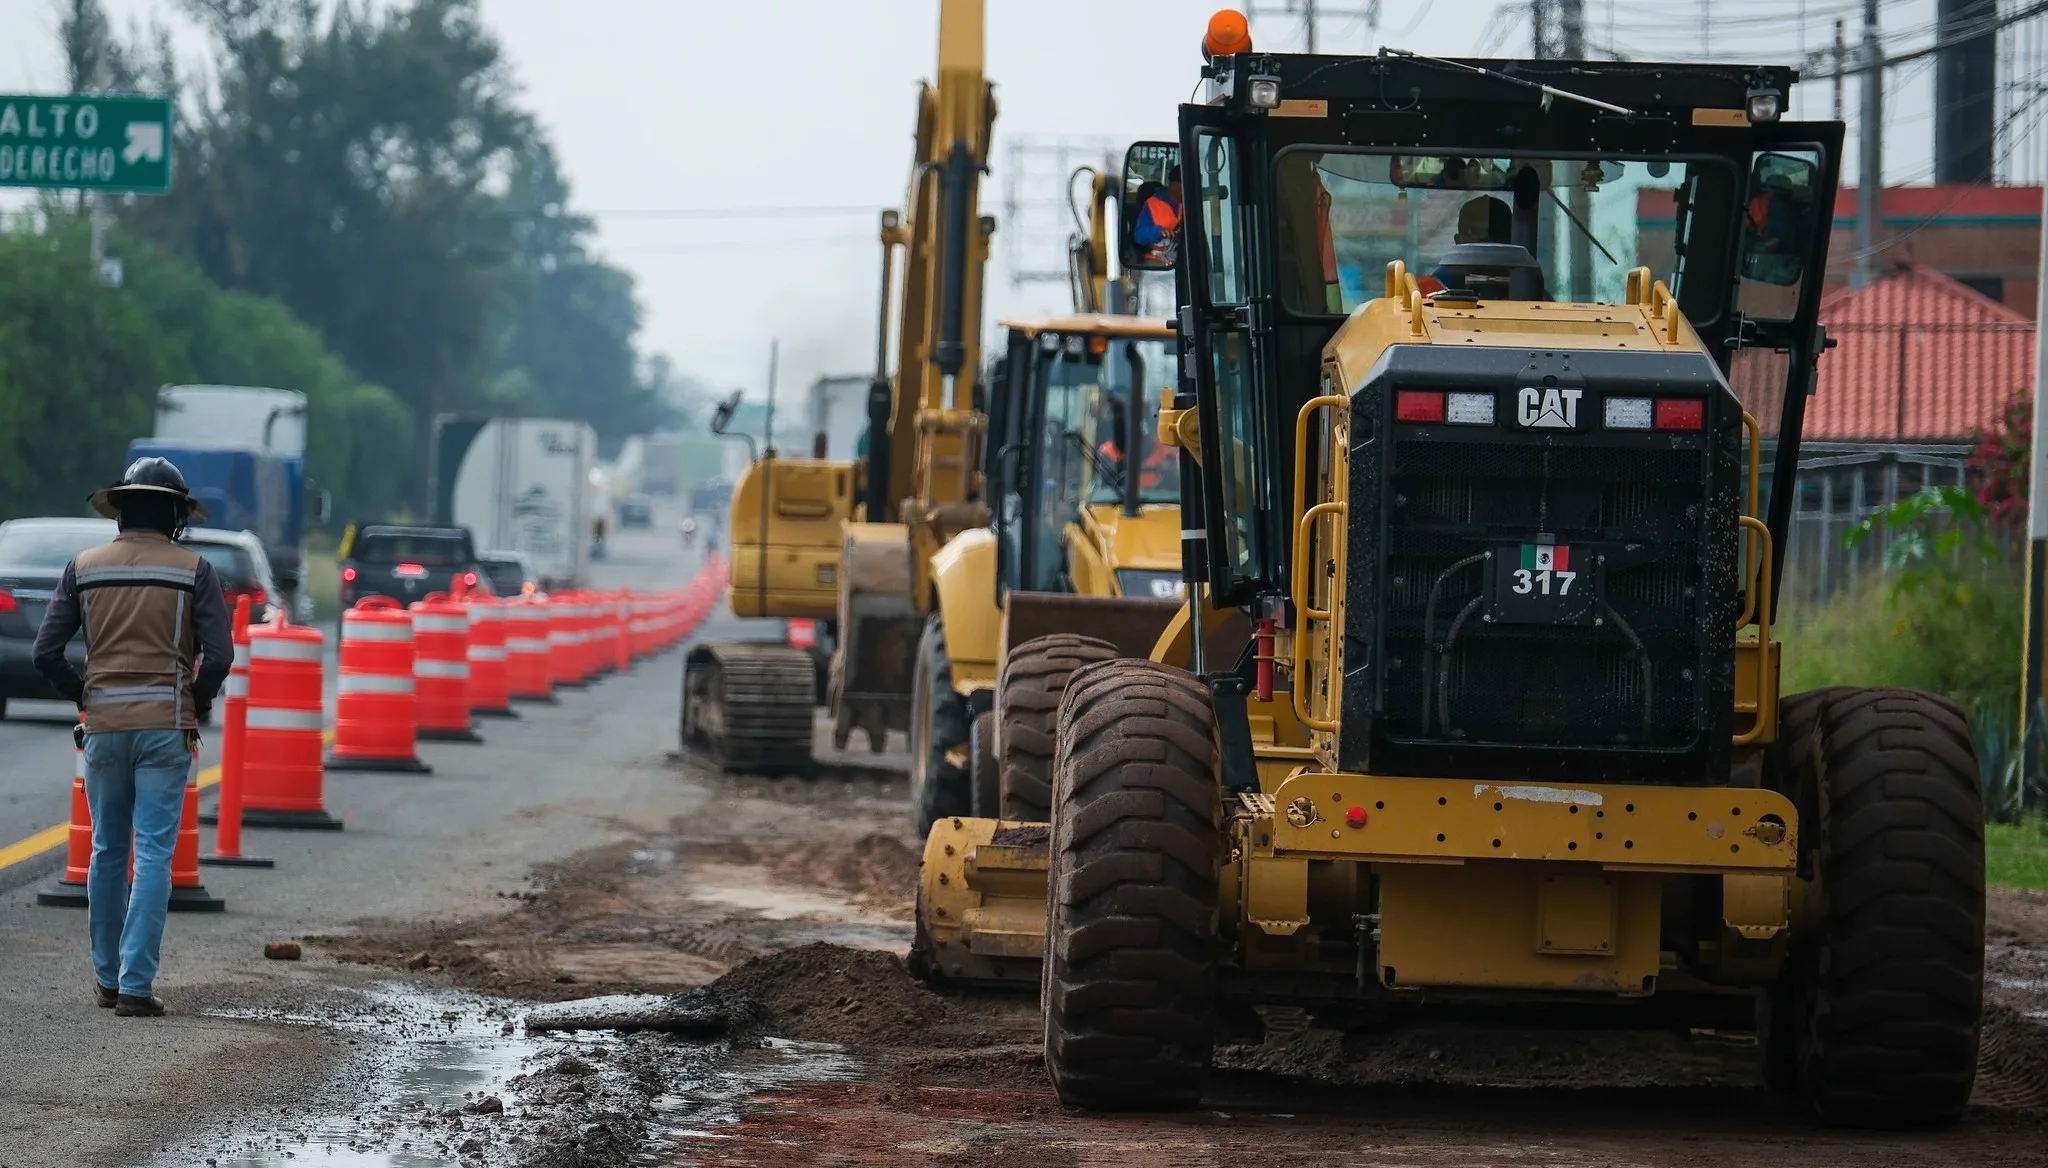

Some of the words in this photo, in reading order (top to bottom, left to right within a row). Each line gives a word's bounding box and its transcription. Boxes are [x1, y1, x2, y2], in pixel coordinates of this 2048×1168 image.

[0, 103, 98, 138] ALTO
[0, 145, 115, 181] DERECHO
[1518, 387, 1582, 427] CAT
[1512, 569, 1577, 595] 317
